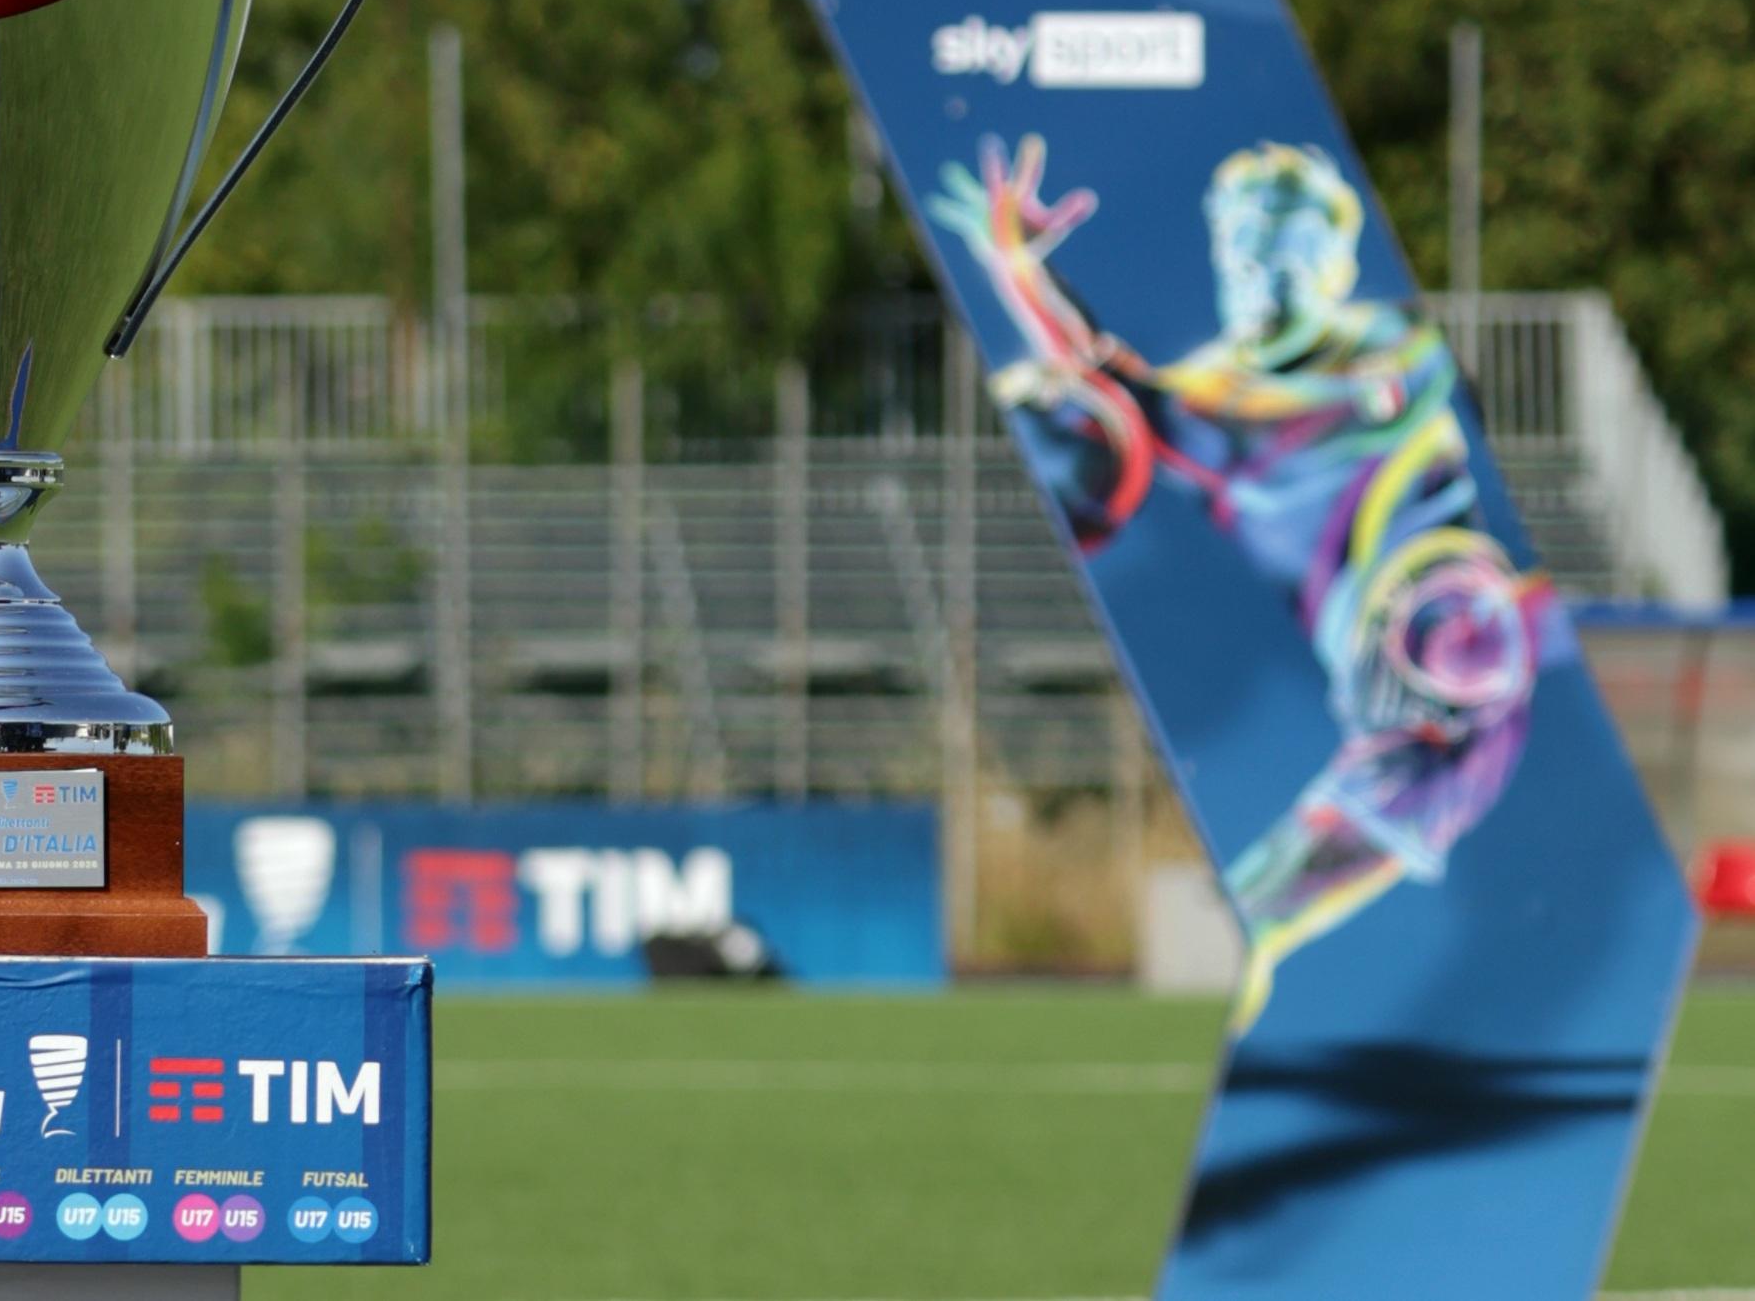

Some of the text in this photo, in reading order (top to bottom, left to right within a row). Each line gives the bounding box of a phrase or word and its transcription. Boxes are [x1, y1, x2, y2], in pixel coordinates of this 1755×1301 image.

[931, 15, 1031, 85] sky
[59, 786, 96, 803] TIM
[4, 835, 96, 853] D'ITALIA
[517, 846, 734, 958] TIM
[238, 1060, 380, 1125] TIM
[55, 1168, 153, 1185] DILETTANTI
[174, 1170, 265, 1187] FEMMINILE
[302, 1172, 369, 1188] FUTSAL
[63, 1207, 141, 1225] U17 U15
[180, 1209, 258, 1227] U17 U15
[293, 1210, 371, 1229] U17 U15
